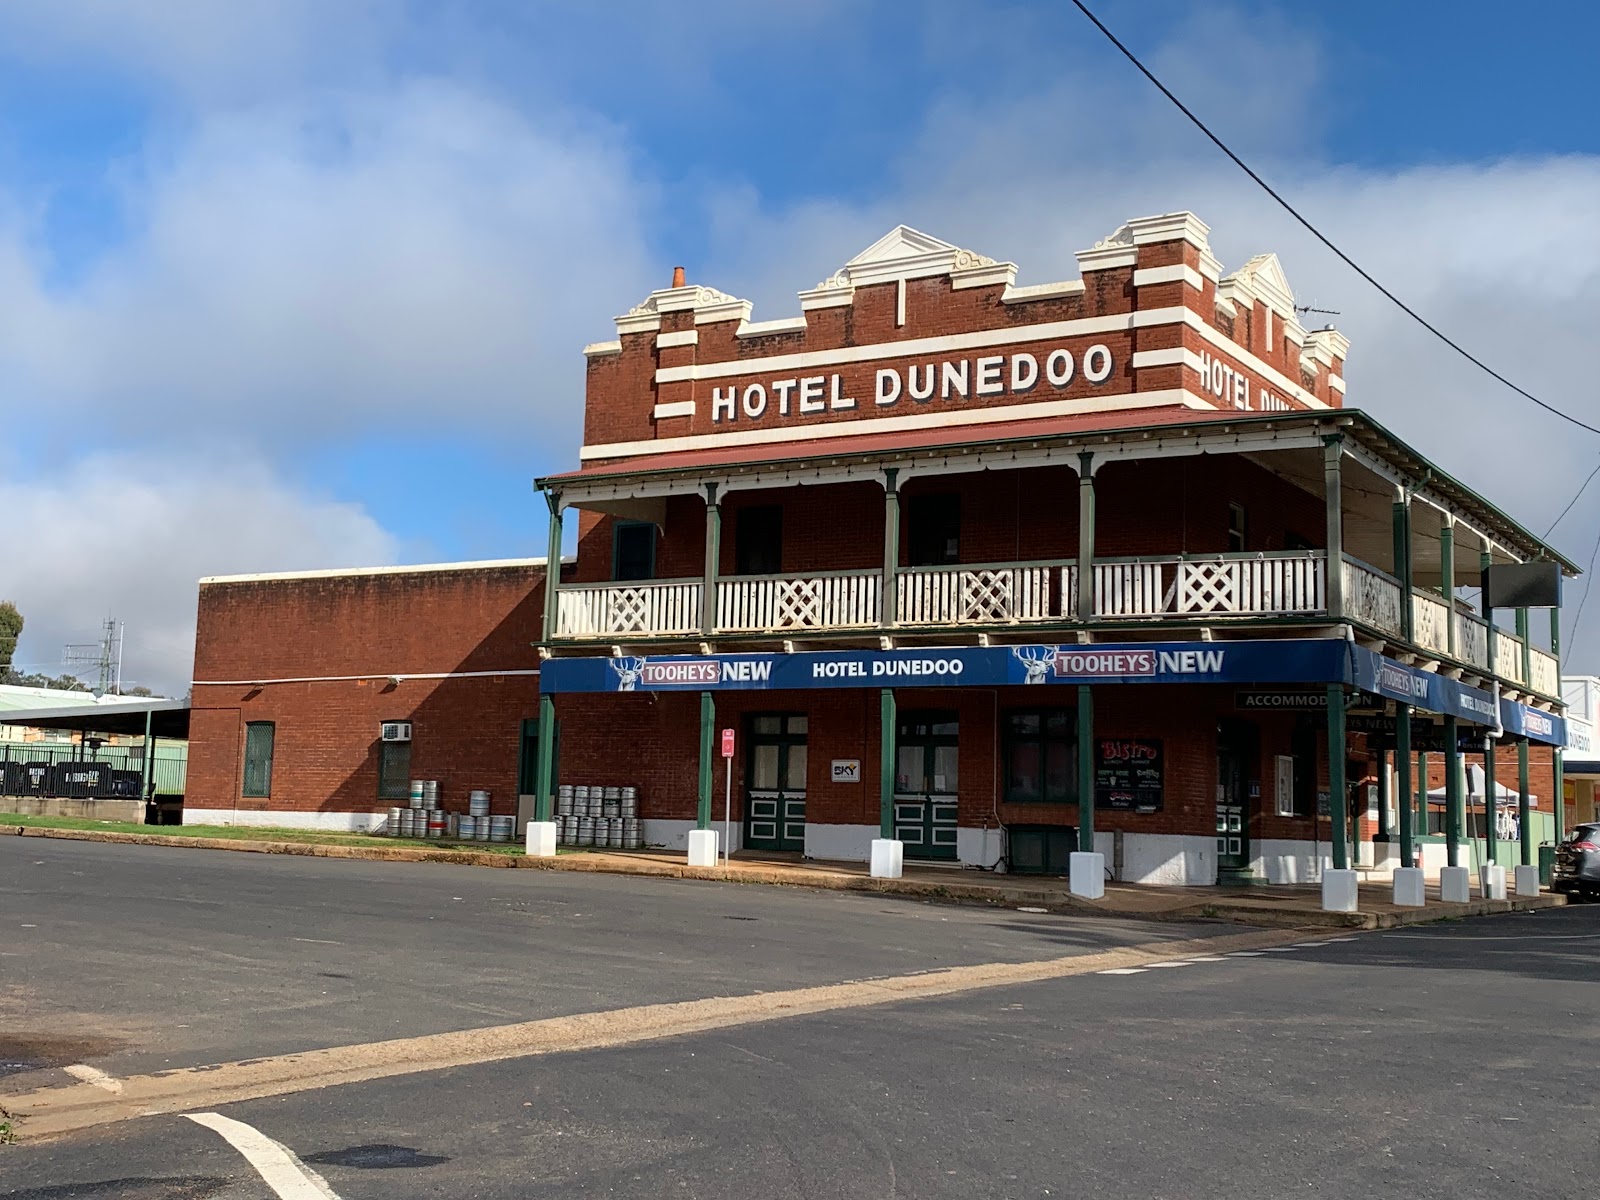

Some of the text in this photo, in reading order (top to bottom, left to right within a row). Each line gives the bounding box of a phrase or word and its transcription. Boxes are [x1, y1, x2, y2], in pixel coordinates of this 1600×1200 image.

[712, 343, 1114, 423] HOTEL DUNEDOO
[1200, 349, 1255, 411] HOTEL
[645, 660, 772, 682] TOOHEYS NEW
[812, 658, 964, 678] HOTEL DUNEDOO
[1059, 650, 1224, 674] TOOHEYS NEW
[1383, 667, 1429, 699] TOOHEYS NEW
[1459, 693, 1475, 711] HOTEL
[1101, 741, 1157, 760] Bistro
[833, 763, 858, 776] SKY
